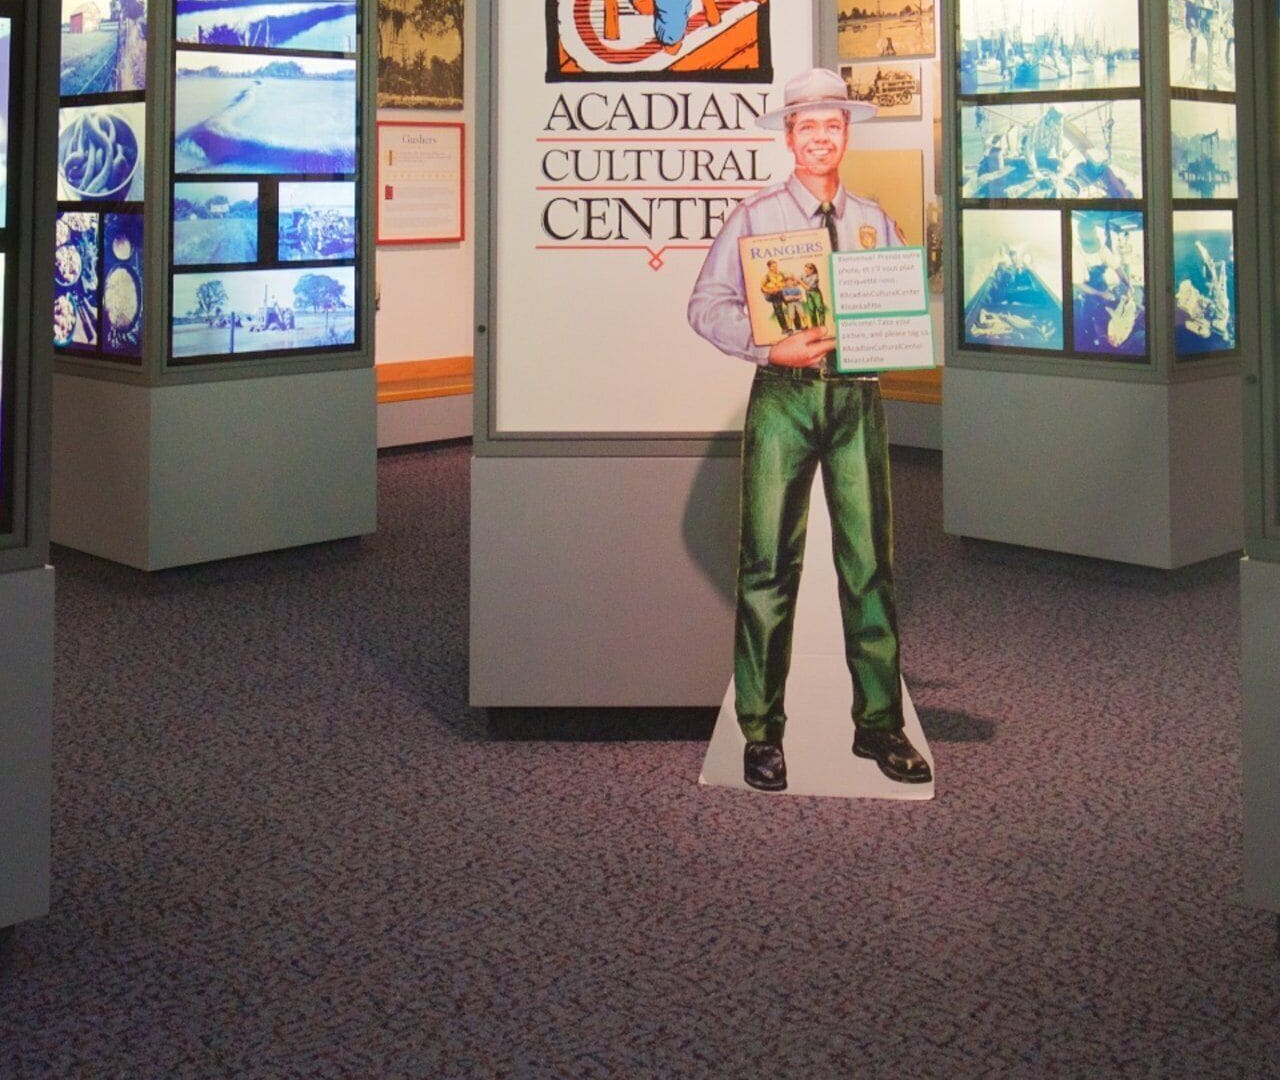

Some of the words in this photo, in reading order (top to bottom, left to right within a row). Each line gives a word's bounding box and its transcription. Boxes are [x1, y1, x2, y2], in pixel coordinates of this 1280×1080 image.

[543, 92, 769, 131] ACADIAN
[542, 149, 772, 182] CULTURAL
[541, 197, 746, 241] CENTE
[750, 241, 823, 260] RANGERS
